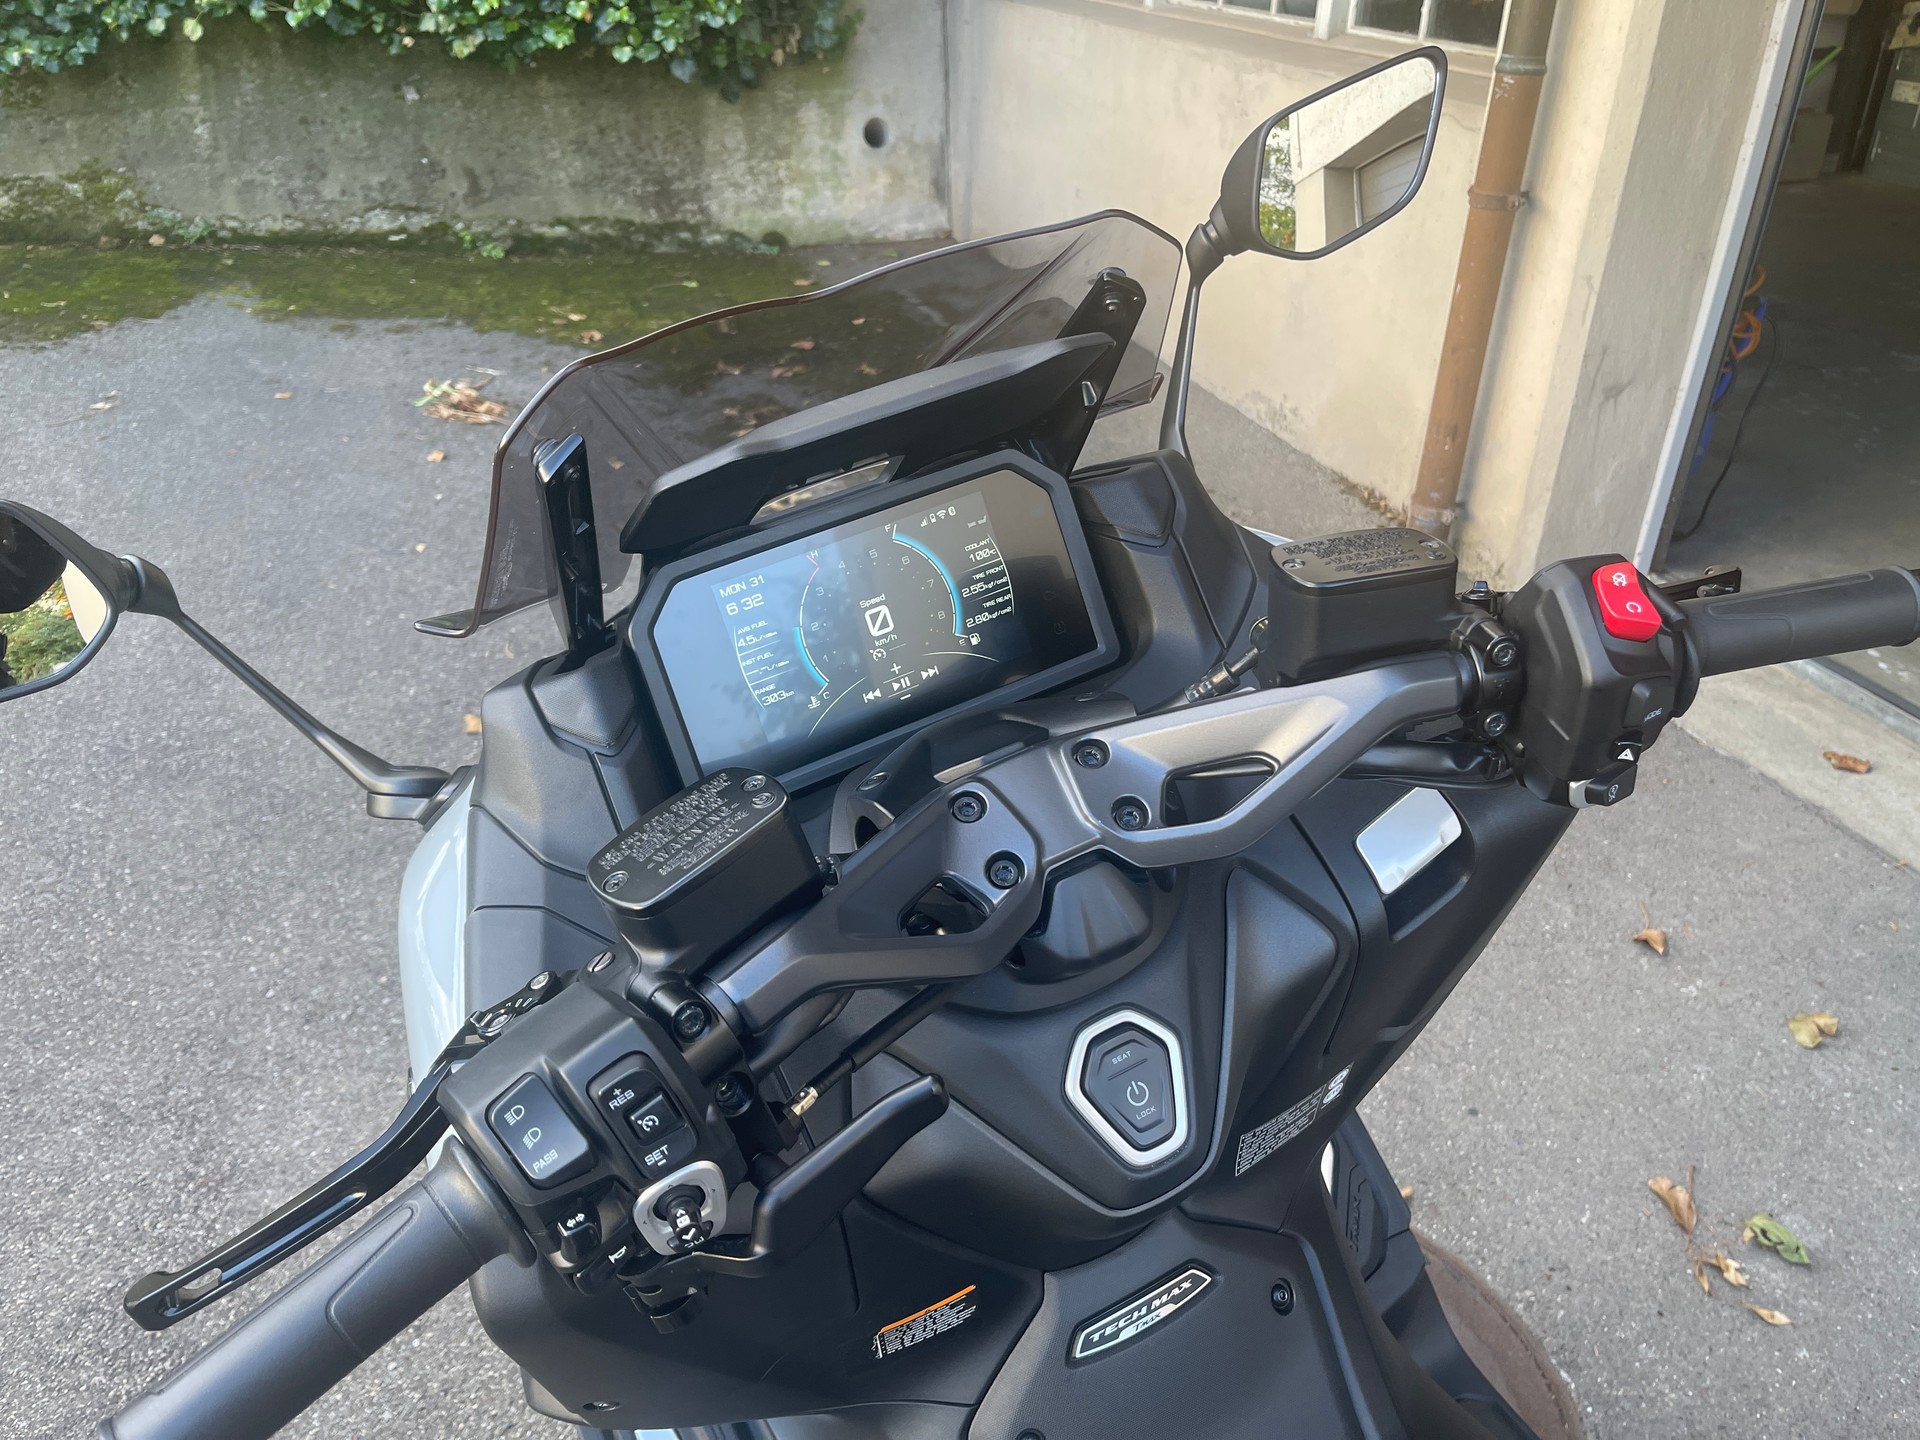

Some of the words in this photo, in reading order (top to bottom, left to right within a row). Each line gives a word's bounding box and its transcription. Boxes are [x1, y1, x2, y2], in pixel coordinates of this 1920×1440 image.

[964, 537, 991, 552] COOLANT
[810, 549, 819, 559] H
[868, 549, 878, 559] 5
[901, 555, 911, 565] 6
[838, 560, 846, 570] 4
[972, 571, 986, 580] TIRE
[985, 564, 1004, 576] FRONT
[719, 581, 747, 598] MON
[749, 574, 765, 588] 31
[926, 578, 935, 588] 7
[815, 586, 825, 597] 3
[859, 593, 886, 609] Speed
[982, 599, 996, 609] TIRE
[995, 593, 1012, 604] REAR
[864, 604, 895, 637] 0
[937, 610, 946, 620] 8
[737, 624, 752, 635] AVG
[751, 620, 769, 630] FUEL
[811, 621, 820, 631] 2
[874, 633, 898, 648] km/h
[756, 651, 775, 662] FUEL
[755, 683, 777, 696] RANGE
[1111, 1050, 1132, 1065] SEAT
[608, 1089, 635, 1110] RES
[1135, 1105, 1157, 1120] LOCK
[532, 1148, 559, 1173] PASS
[644, 1145, 670, 1167] SET
[1088, 1305, 1148, 1342] TECH
[1150, 1278, 1193, 1310] MAX
